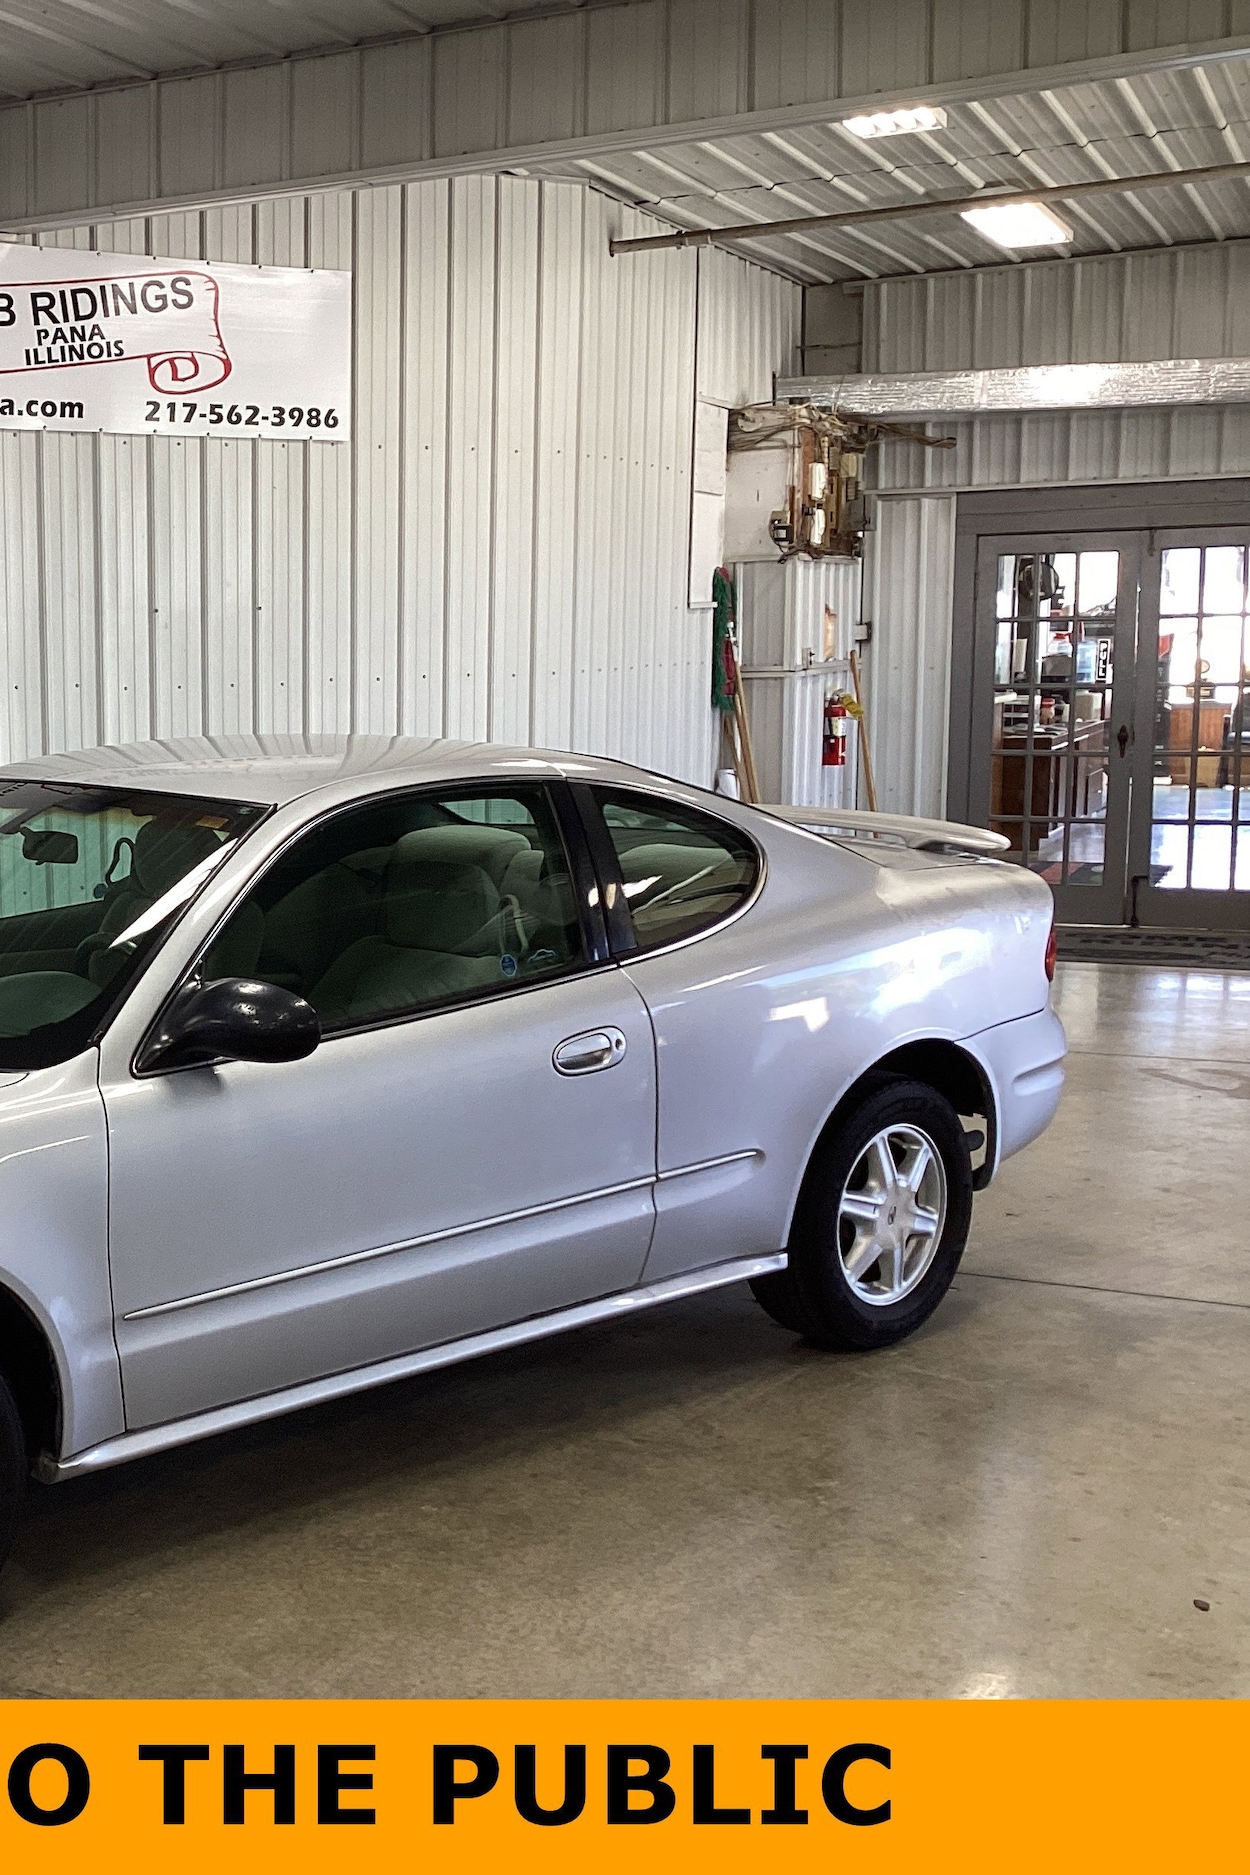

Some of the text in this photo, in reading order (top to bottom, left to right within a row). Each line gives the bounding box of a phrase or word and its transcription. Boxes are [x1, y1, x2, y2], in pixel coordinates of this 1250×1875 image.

[30, 276, 194, 326] RIDINGS
[37, 325, 106, 346] PANA
[25, 340, 125, 366] ILLINOIS
[146, 402, 340, 430] 217-562-3986
[1098, 642, 1108, 677] PULL
